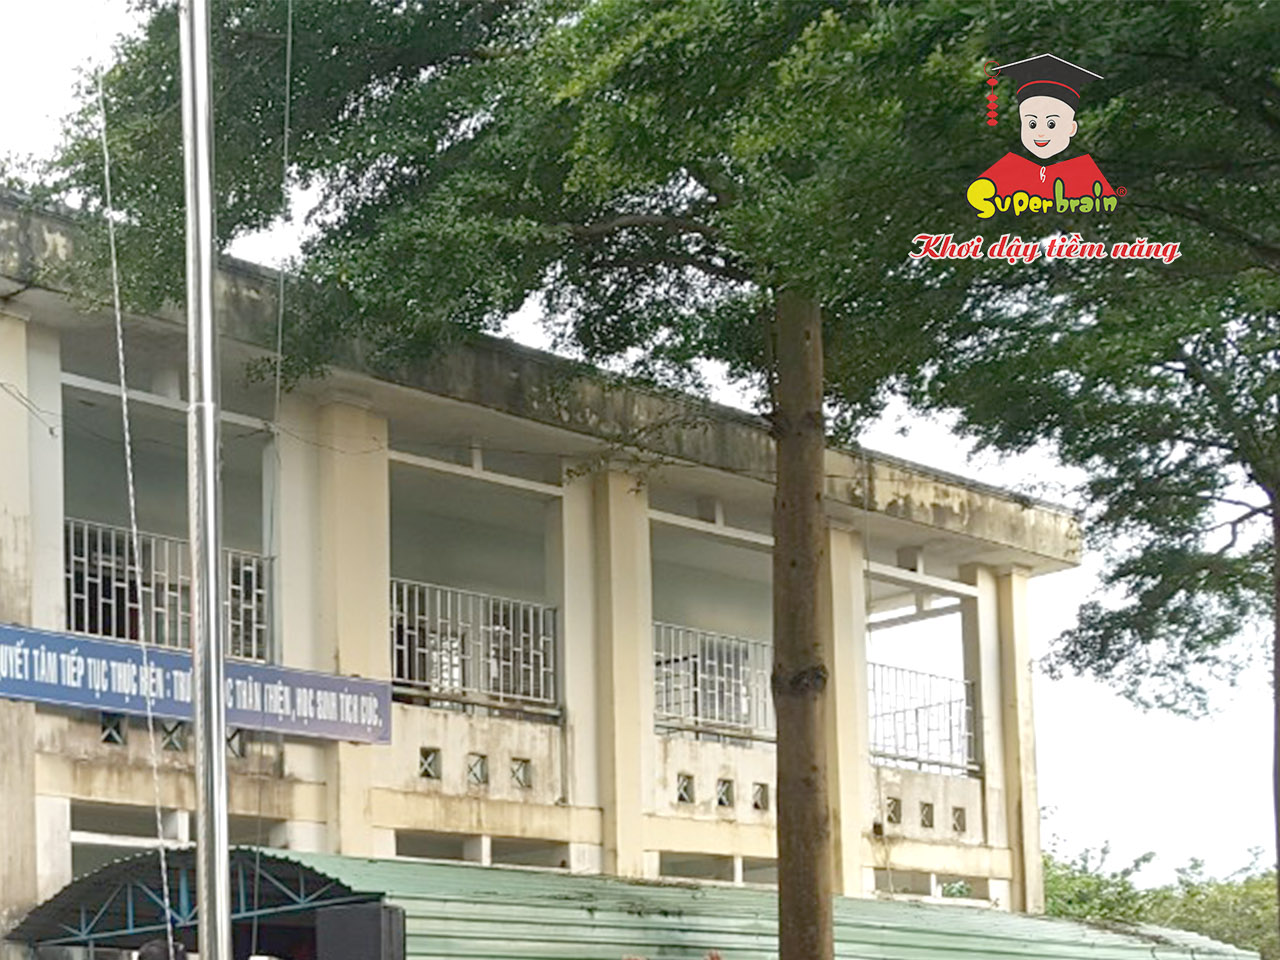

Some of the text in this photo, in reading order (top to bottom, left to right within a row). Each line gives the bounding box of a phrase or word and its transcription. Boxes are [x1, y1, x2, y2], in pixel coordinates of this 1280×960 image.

[32, 645, 59, 685] TÂM
[59, 648, 85, 688] TIẾP
[87, 657, 109, 699] TỤC
[110, 658, 137, 703] THỰC
